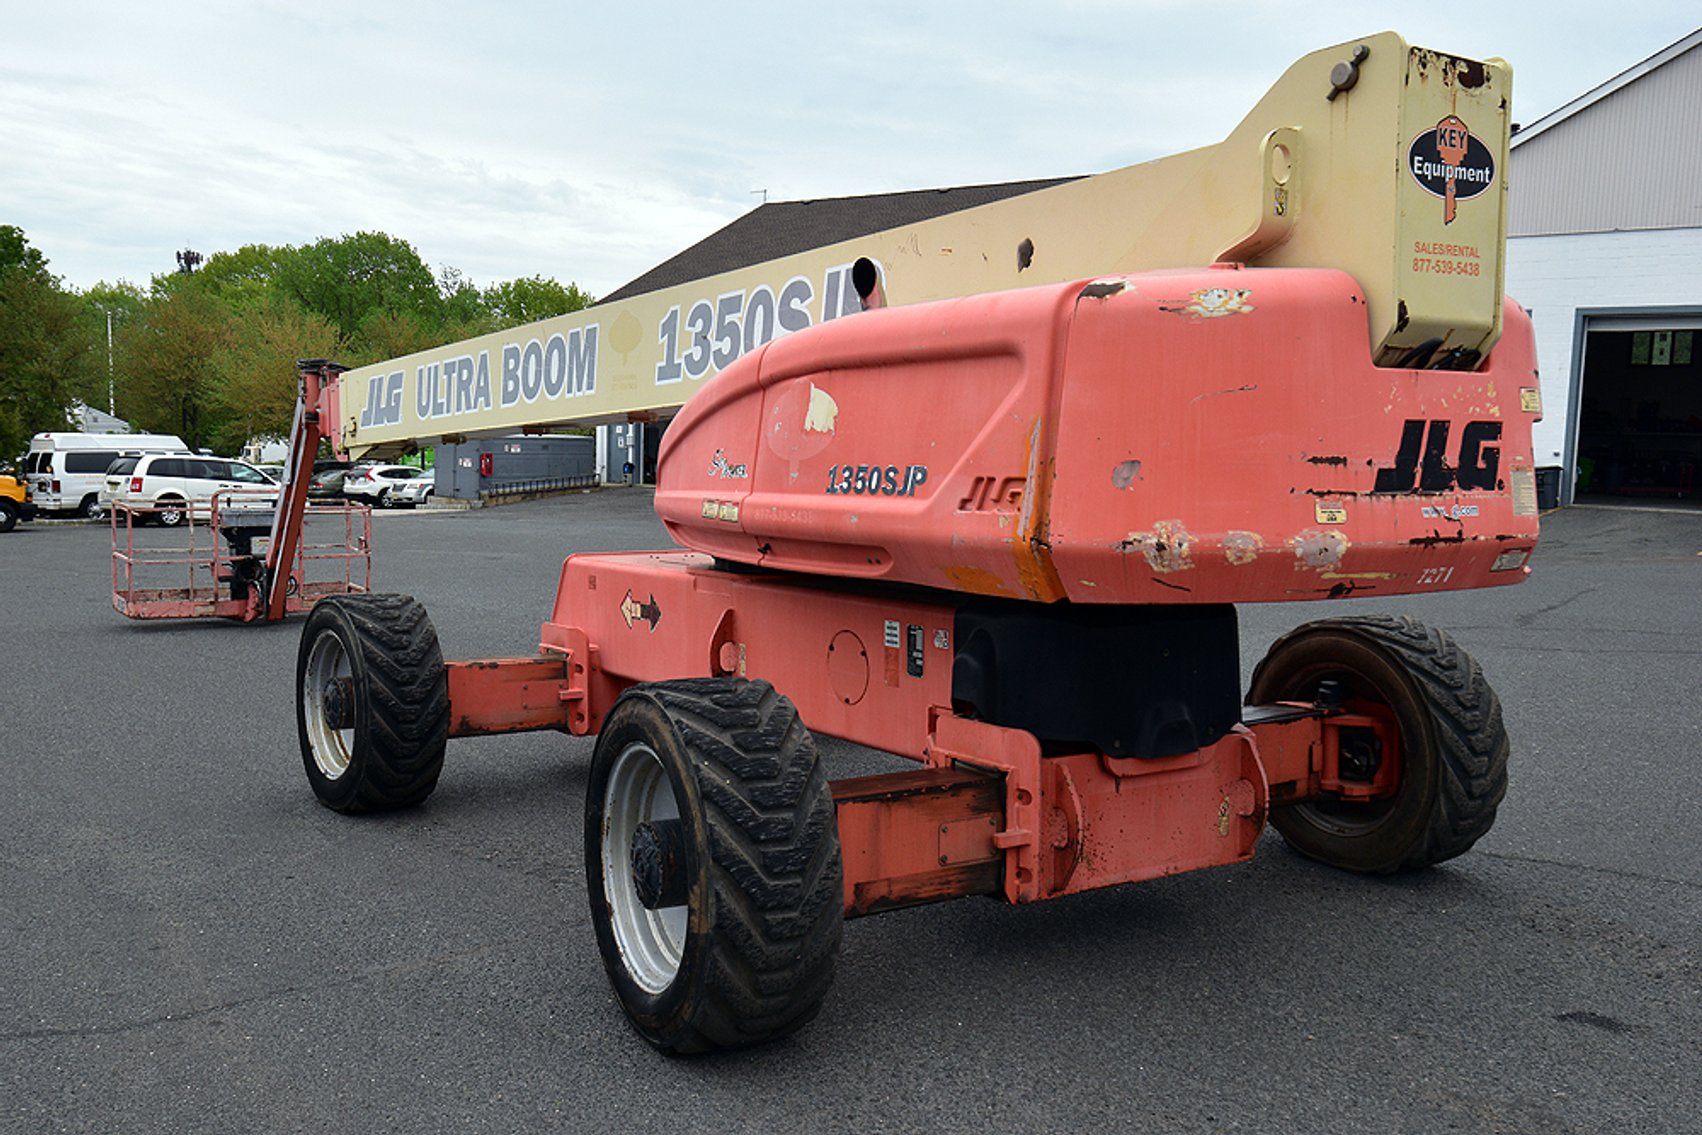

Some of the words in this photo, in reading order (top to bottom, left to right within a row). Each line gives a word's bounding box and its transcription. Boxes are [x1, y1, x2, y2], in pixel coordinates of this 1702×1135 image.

[1438, 127, 1468, 149] KEY
[1413, 156, 1491, 184] Equipment
[1414, 241, 1480, 258] SALES/RENTAL
[1412, 257, 1480, 276] 877-539-5438
[360, 370, 405, 429] JLG
[416, 350, 492, 420] ULTRA
[500, 323, 599, 408] BOOM
[1374, 419, 1503, 492] JLG
[826, 464, 928, 497] 1350SJP
